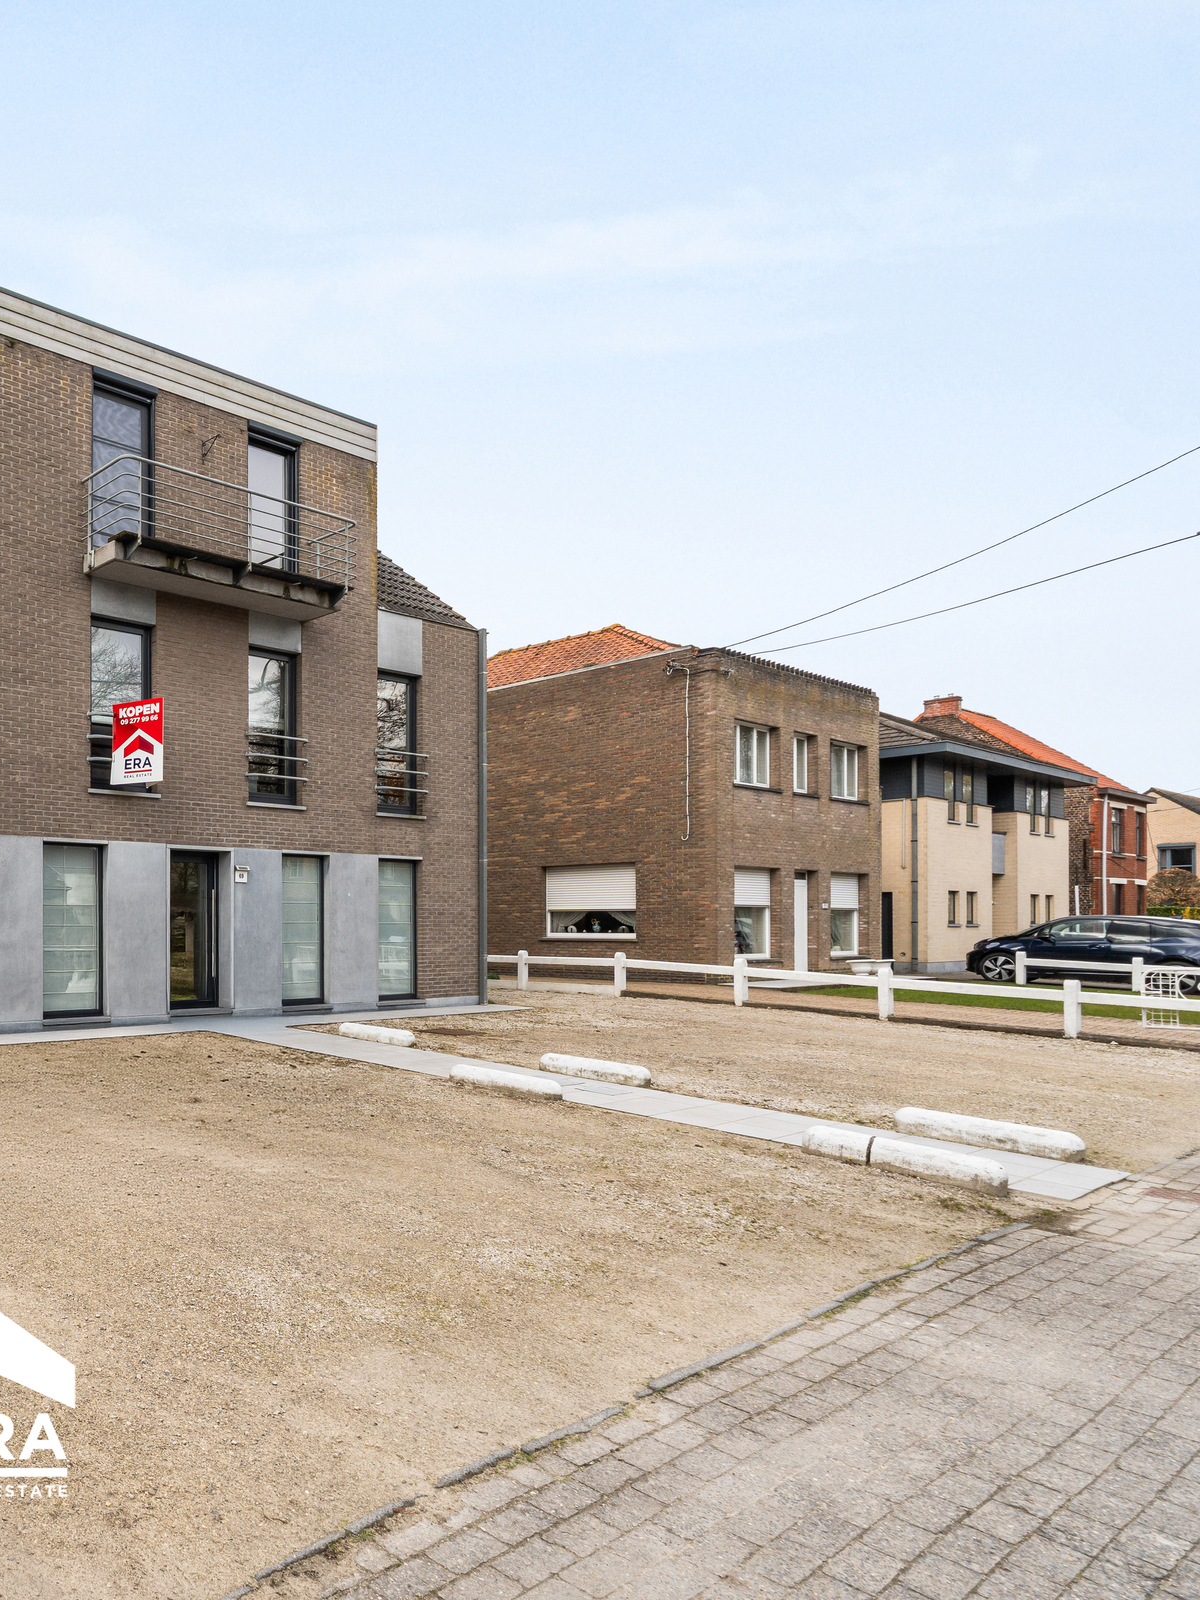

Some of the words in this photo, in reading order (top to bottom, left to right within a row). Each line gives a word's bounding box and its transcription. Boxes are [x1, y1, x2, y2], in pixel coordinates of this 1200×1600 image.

[119, 702, 160, 719] KOPEN
[141, 715, 149, 723] 99
[124, 757, 152, 770] ERA
